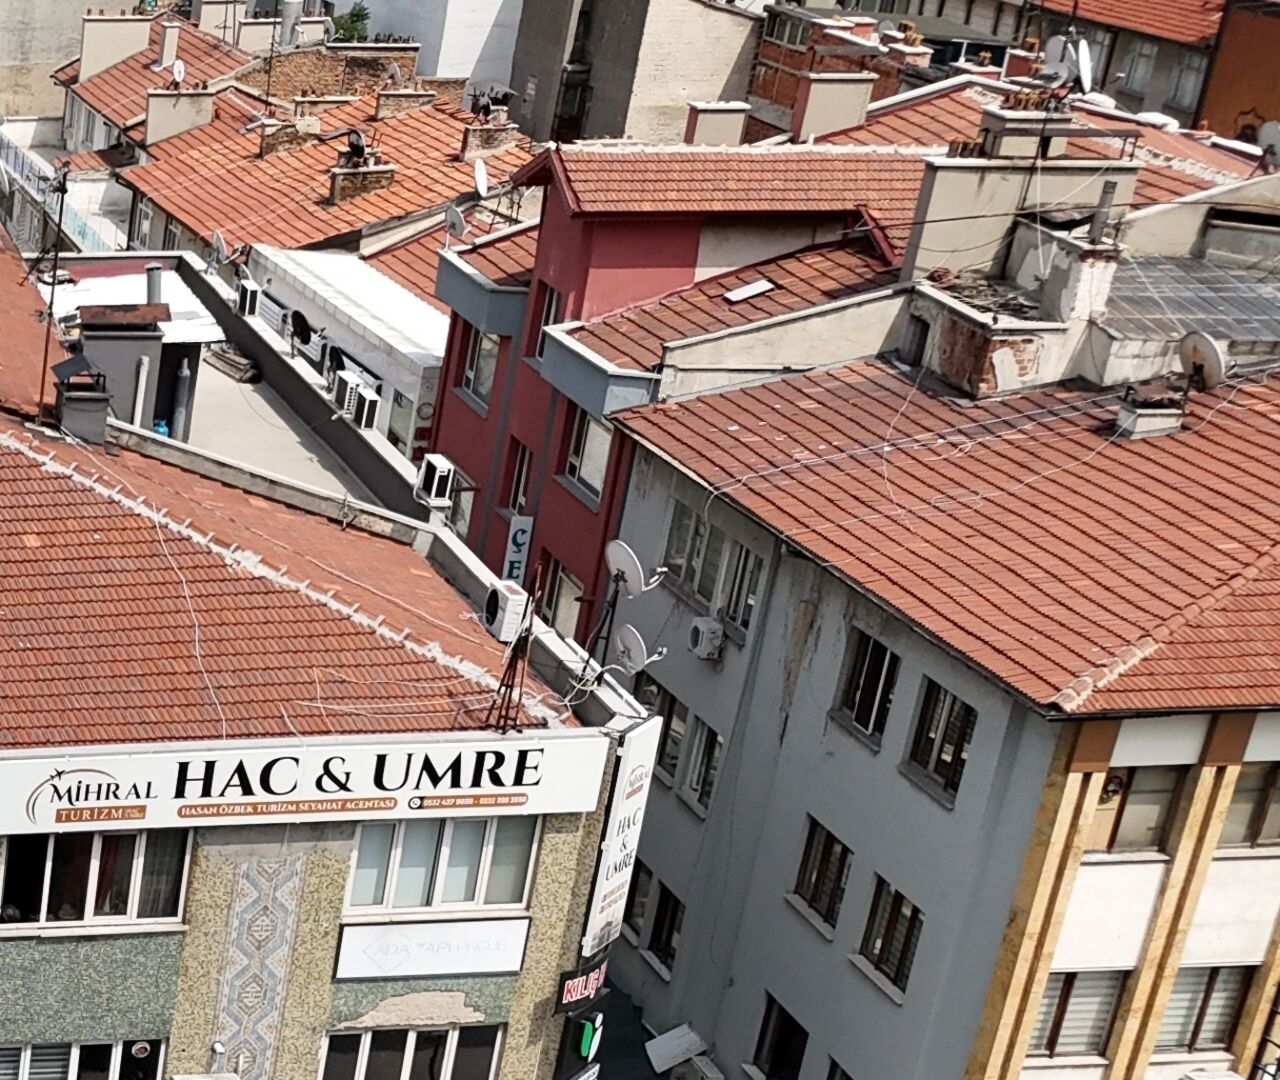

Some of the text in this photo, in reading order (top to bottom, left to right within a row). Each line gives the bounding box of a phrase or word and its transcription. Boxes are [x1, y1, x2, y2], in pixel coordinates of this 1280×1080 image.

[172, 748, 544, 799] HAC & UMRE
[60, 808, 123, 821] TURİZM
[181, 798, 395, 817] HASAN ÖZBEK TURİZM SEYAHAT ACENTASI
[616, 807, 641, 837] HAC
[606, 848, 635, 881] UMRE
